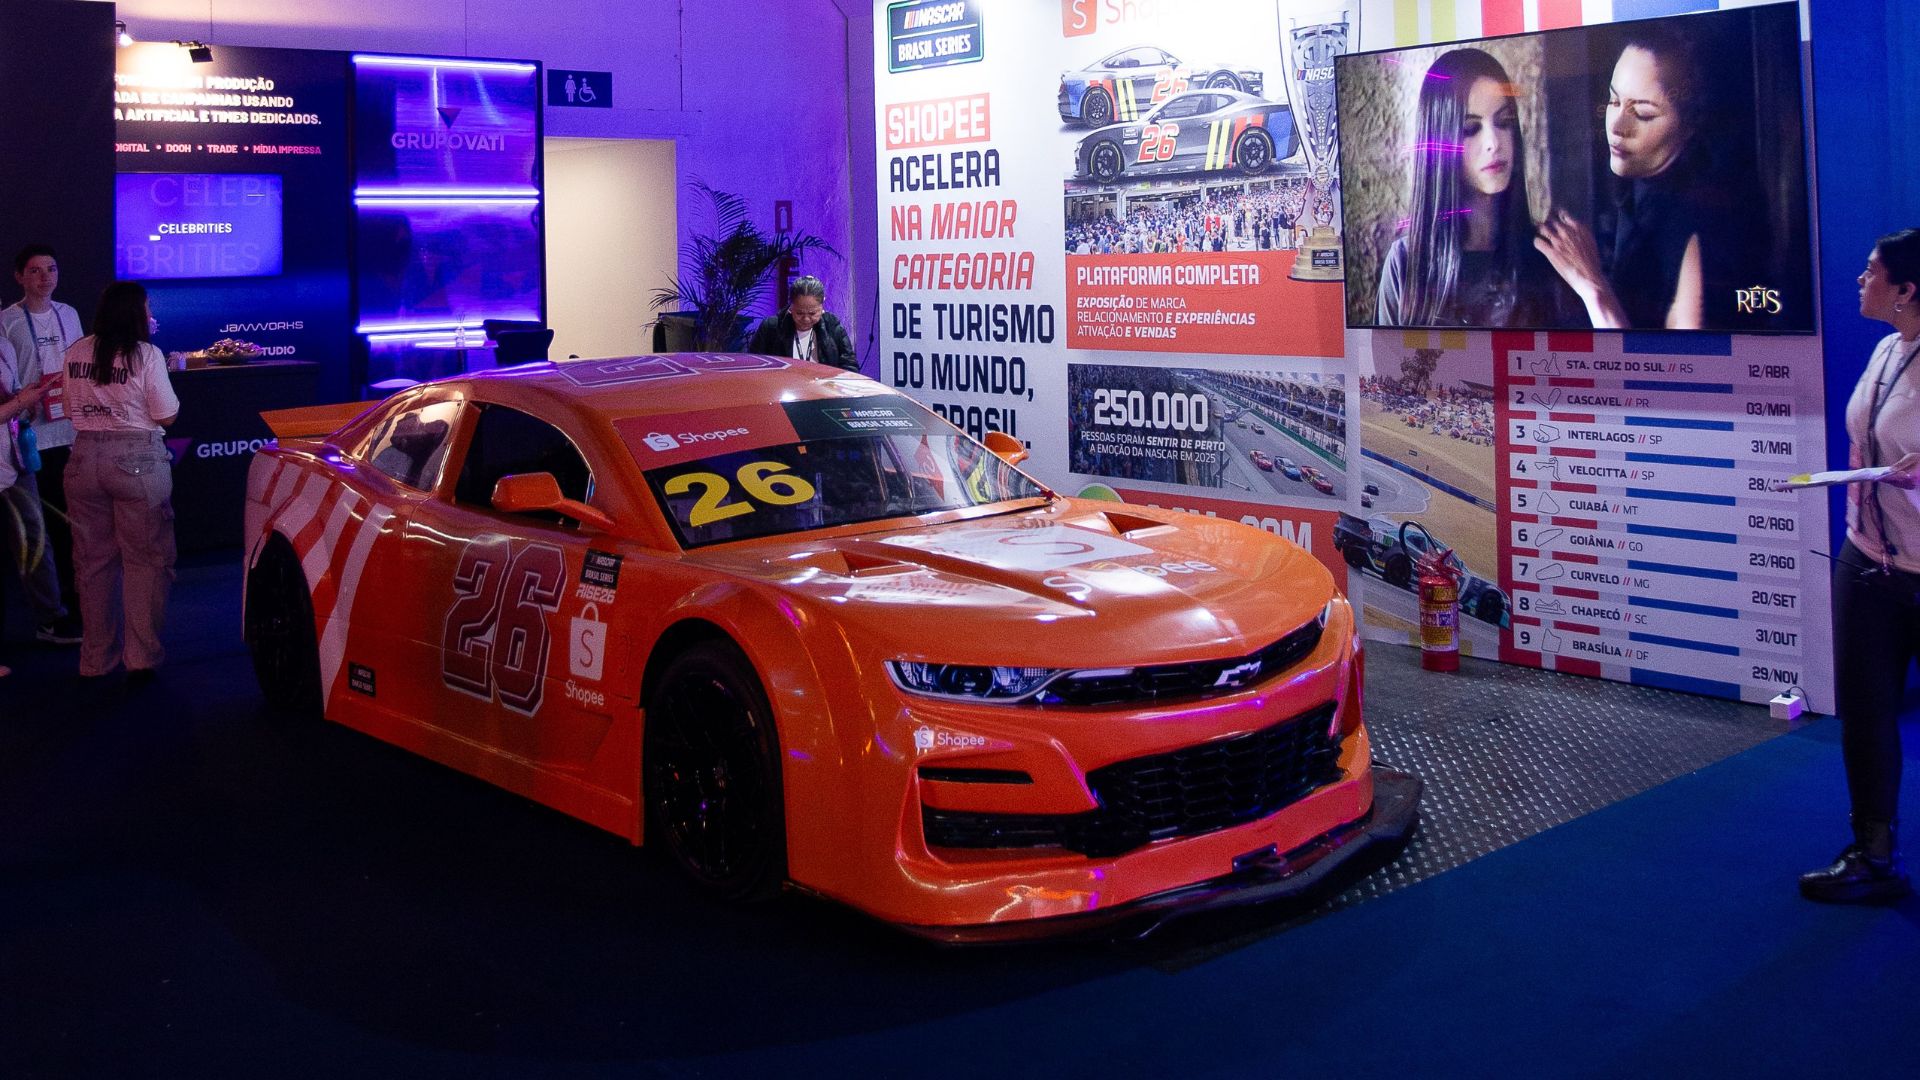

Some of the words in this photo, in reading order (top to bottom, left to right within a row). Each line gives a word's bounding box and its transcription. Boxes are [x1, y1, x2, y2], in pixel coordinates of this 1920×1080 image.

[919, 2, 965, 27] NASCAR
[898, 40, 934, 61] BRASIL
[935, 34, 971, 56] SERIES
[206, 76, 274, 92] PRODUÇÃO
[244, 95, 293, 107] USANDO
[126, 109, 199, 122] ARTIFICIAL
[200, 110, 209, 122] E
[211, 111, 249, 123] TIMES
[251, 112, 321, 124] DEDICADOS.
[889, 98, 985, 145] SHOPEE
[166, 144, 191, 153] DOOH
[207, 144, 238, 154] TRADE
[253, 143, 278, 154] MÍDIA
[278, 145, 321, 155] IMPRESSA
[391, 132, 505, 151] GRUPOVATI
[1138, 123, 1179, 163] 26
[890, 149, 1000, 192] ACELERA
[158, 223, 232, 234] CELEBRITIES
[891, 205, 922, 241] NA
[930, 200, 1017, 240] MAIOR
[893, 251, 1035, 290] CATEGORIA
[1077, 265, 1172, 286] PLATAFORMA
[1175, 264, 1259, 285] COMPLETA
[1076, 294, 1133, 311] EXPOSIÇÃO
[1136, 297, 1148, 309] DE
[1151, 297, 1186, 309] MARCA
[893, 303, 922, 339] DE
[933, 303, 1054, 344] TURISMO
[1077, 311, 1163, 324] RELACIONAMENTO
[1165, 312, 1173, 324] E
[1174, 310, 1256, 325] EXPERIÊNCIAS
[1077, 324, 1123, 339] ATIVAÇÃO
[1125, 327, 1131, 337] E
[1134, 327, 1177, 338] VENDAS
[1516, 357, 1522, 370] 1
[1566, 360, 1590, 370] STA.
[1593, 361, 1621, 371] CRUZ
[1625, 362, 1640, 371] DO
[1643, 362, 1665, 372] SUL
[1680, 363, 1694, 373] RS
[1748, 364, 1790, 379] 12/ABR
[894, 352, 924, 388] DO
[931, 353, 1034, 402] MUNDO,
[1516, 391, 1525, 404] 2
[1567, 395, 1622, 407] CASCAVEL
[1635, 398, 1649, 408] PR
[1094, 388, 1208, 432] 250.000
[1746, 402, 1791, 417] 03/MAI
[677, 427, 749, 444] Shopee
[1081, 431, 1115, 443] PESSOAS
[1117, 434, 1145, 445] FORAM
[1147, 437, 1178, 448] SENTIR
[1180, 439, 1192, 449] DE
[1195, 440, 1225, 451] PERTO
[1516, 425, 1525, 438] 3
[1568, 430, 1635, 443] INTERLAGOS
[1649, 436, 1662, 445] SP
[1090, 444, 1096, 453] A
[1098, 444, 1130, 457] EMOÇÃO
[1132, 446, 1144, 457] DA
[1145, 448, 1178, 460] NASCAR
[1180, 450, 1193, 461] EM
[1195, 453, 1216, 463] 2025
[1751, 440, 1792, 455] 31/MAI
[1516, 460, 1526, 473] 4
[1569, 465, 1627, 478] VELOCITTA
[1641, 471, 1655, 480] SP
[664, 460, 816, 528] 26
[1517, 494, 1527, 507] 5
[1569, 500, 1609, 513] CUIABÁ
[1623, 505, 1638, 515] MT
[1748, 515, 1794, 532] 02/AGO
[1518, 528, 1528, 542] 6
[1570, 535, 1614, 549] GOIÂNIA
[1628, 541, 1643, 552] GO
[1750, 553, 1795, 570] 23/AGO
[1519, 562, 1528, 576] 7
[1570, 570, 1619, 585] CURVELO
[1634, 578, 1649, 589] MG
[1751, 590, 1797, 608] 20/SET
[1519, 597, 1529, 611] 8
[1572, 605, 1620, 621] CHAPECÓ
[1635, 614, 1648, 625] SC
[441, 533, 567, 719] 26
[1520, 631, 1530, 644] 9
[1572, 640, 1621, 657] BRASÍLIA
[1637, 650, 1649, 660] DF
[1755, 629, 1797, 647] 31/OUT
[1752, 666, 1799, 685] 29/NOV
[565, 679, 605, 708] Shopee
[937, 732, 985, 749] Shopee
